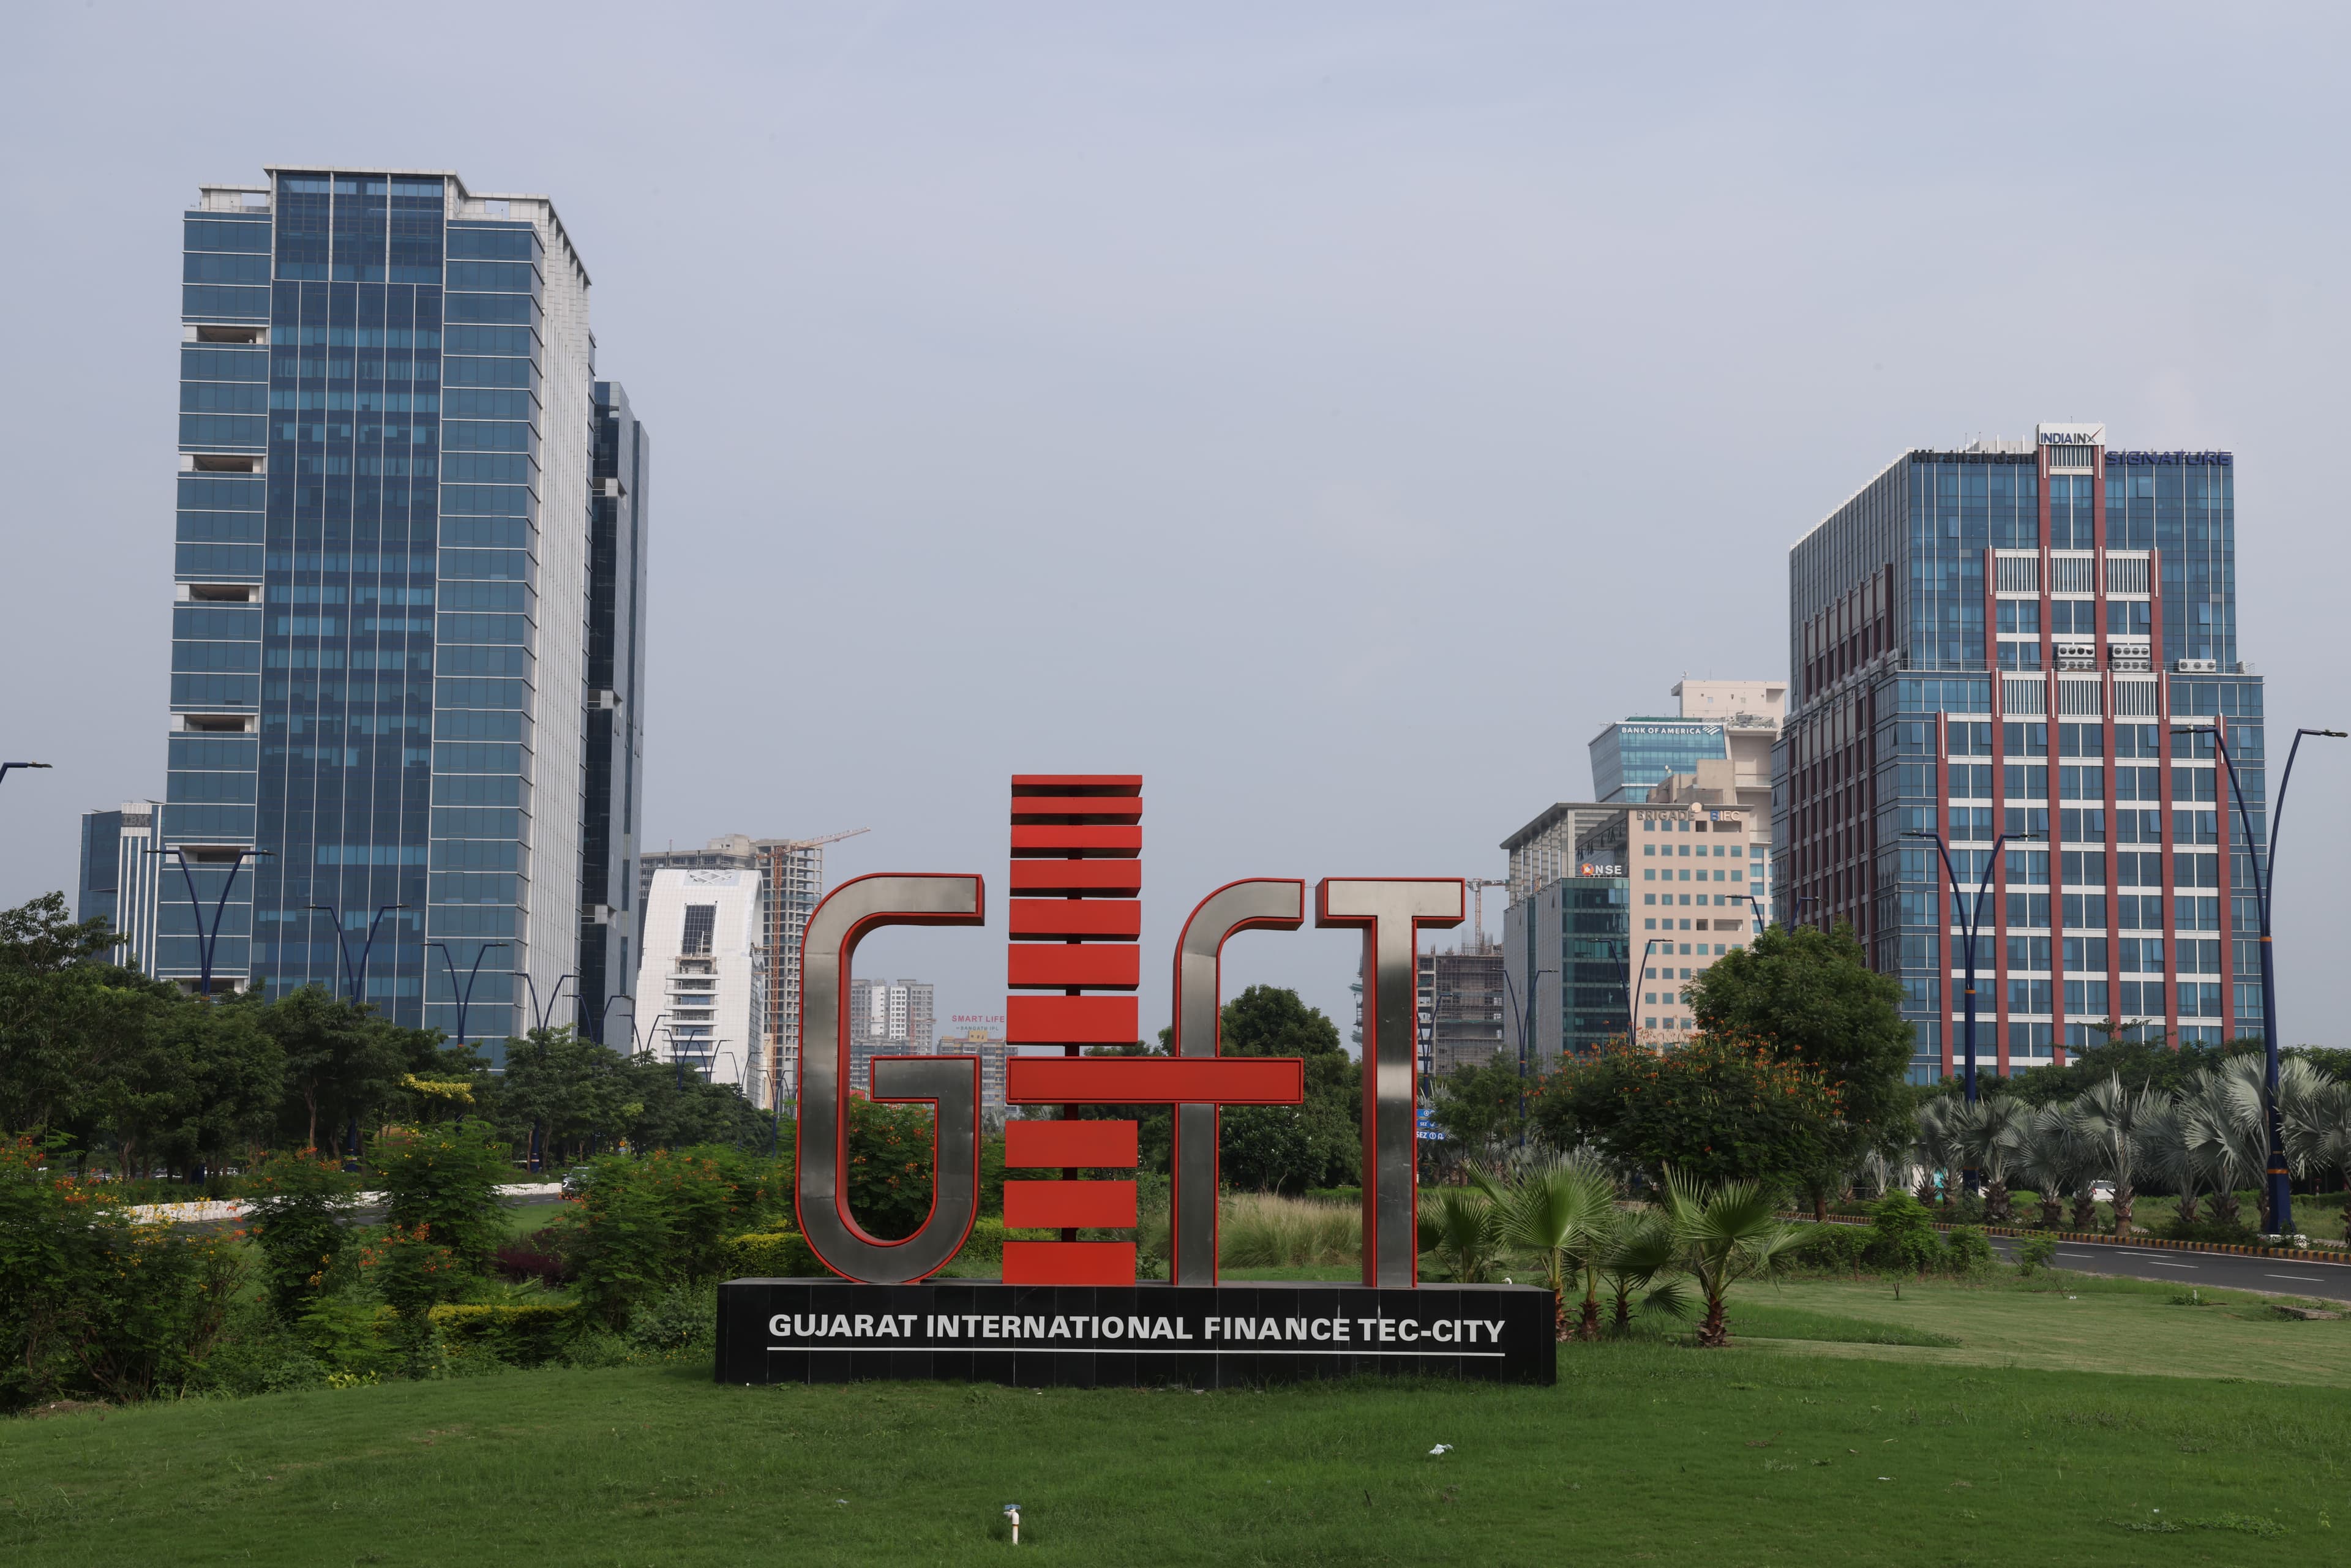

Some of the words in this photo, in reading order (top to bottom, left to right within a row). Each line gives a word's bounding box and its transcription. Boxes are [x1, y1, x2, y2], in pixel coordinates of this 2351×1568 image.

[2105, 451, 2232, 466] SIGNATURE
[122, 814, 150, 826] IBM
[1637, 809, 1696, 821] BRIGADE
[1710, 809, 1740, 822] BIFC
[1595, 865, 1622, 875] NSE
[769, 1314, 917, 1337] GUJARAT
[927, 1315, 1193, 1340] INTERNATIONAL
[1205, 1317, 1350, 1341] FINANCE
[1357, 1318, 1505, 1343] TEC-CITY
